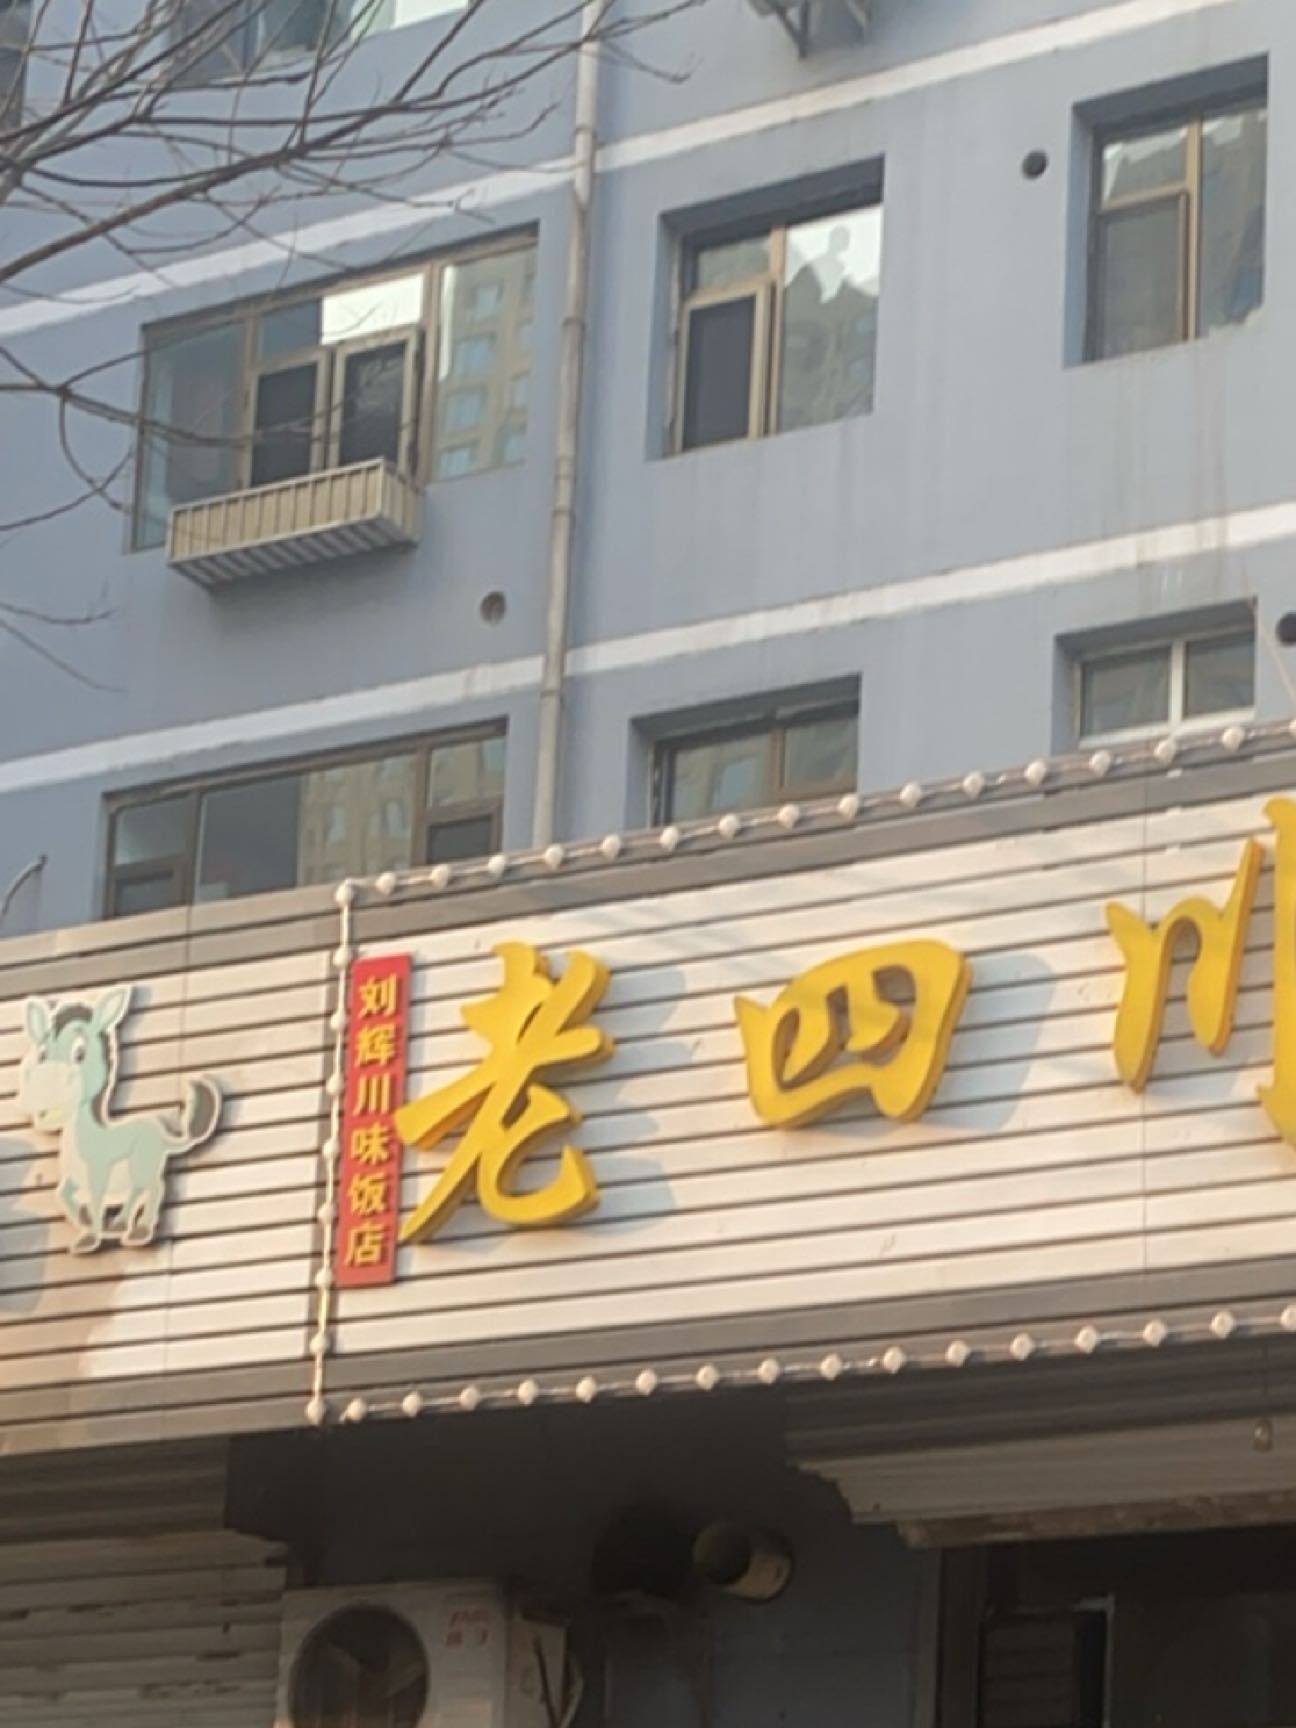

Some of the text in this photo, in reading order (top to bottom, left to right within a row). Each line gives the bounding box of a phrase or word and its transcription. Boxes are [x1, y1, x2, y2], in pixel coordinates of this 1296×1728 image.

[346, 972, 397, 1269] 刘辉川味饭店
